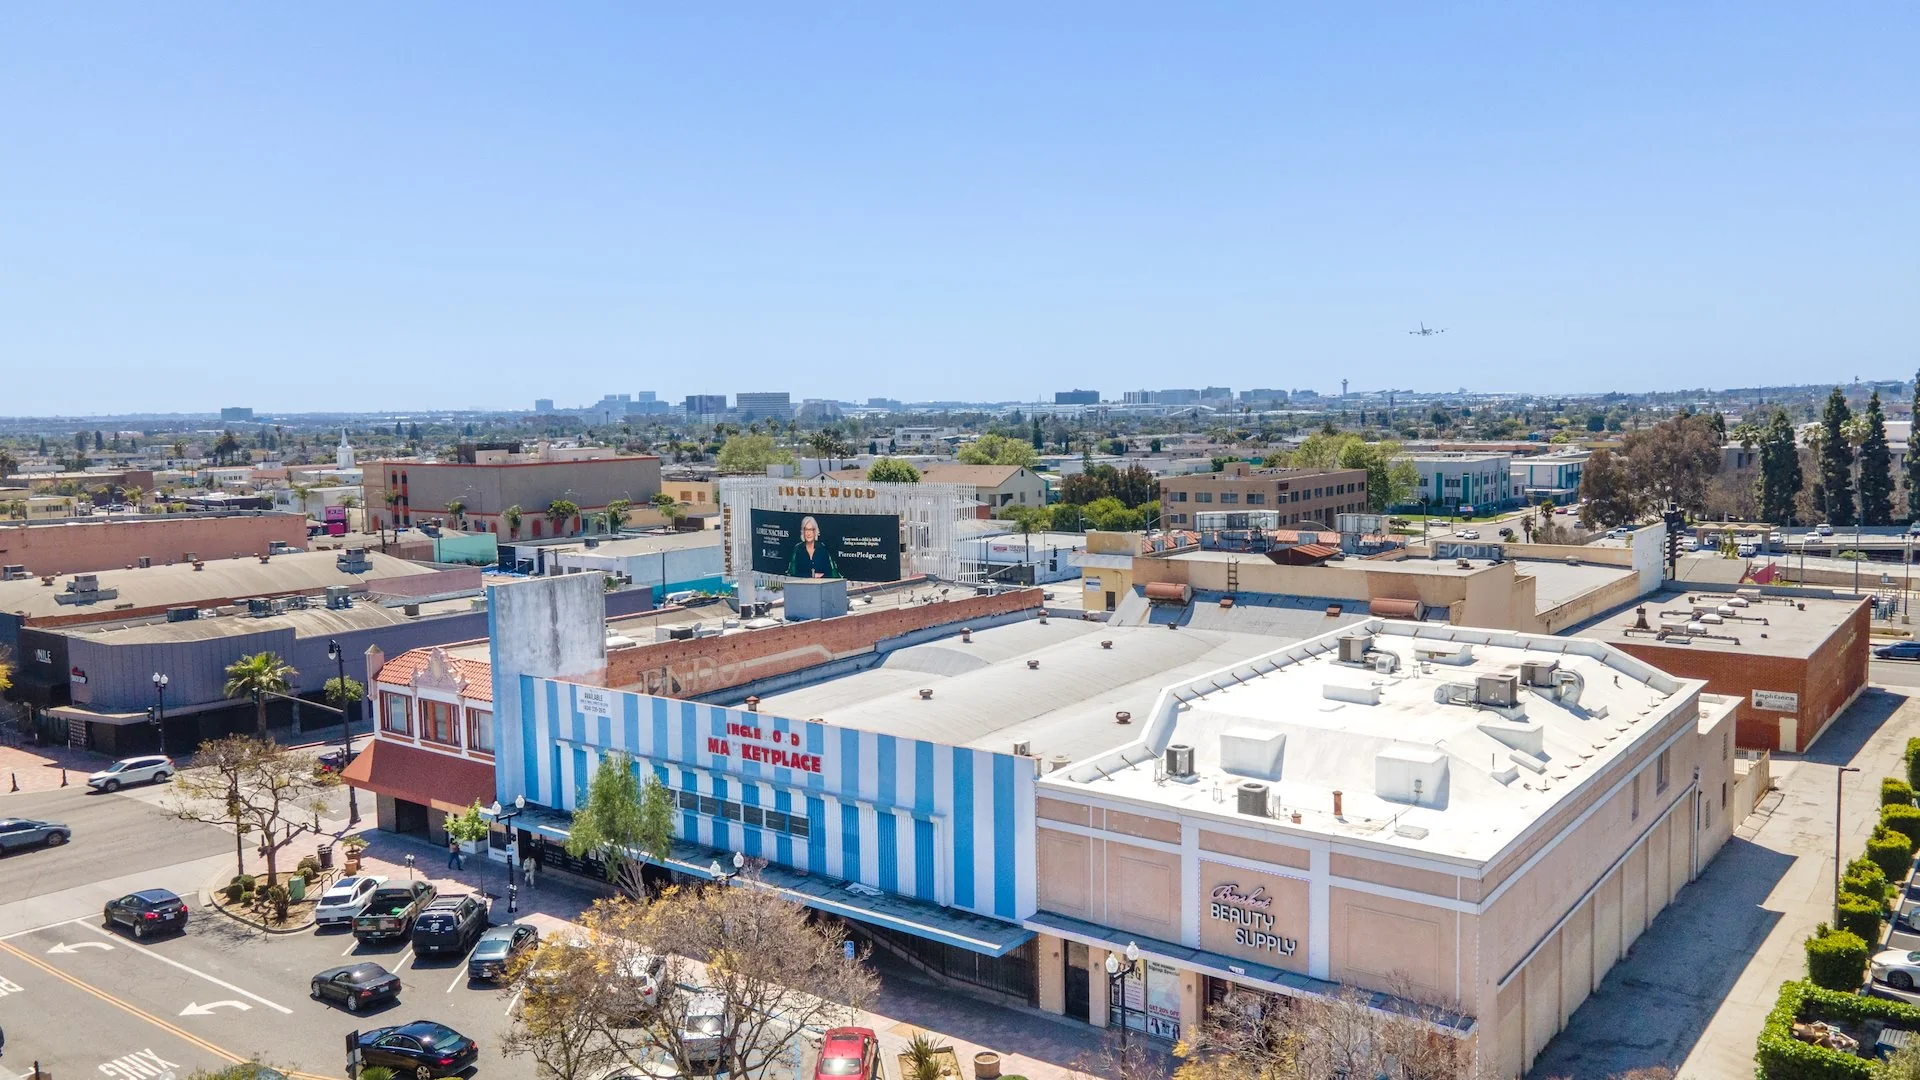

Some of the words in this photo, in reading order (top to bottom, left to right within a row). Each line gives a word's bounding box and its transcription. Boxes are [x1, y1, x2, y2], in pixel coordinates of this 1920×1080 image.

[778, 486, 876, 499] INGLEWOOD
[838, 550, 887, 560] PiercesPledge.org
[707, 737, 822, 773] MAKETPLACE
[1210, 902, 1274, 931] BEAUTY
[1235, 928, 1296, 956] SUPPLY
